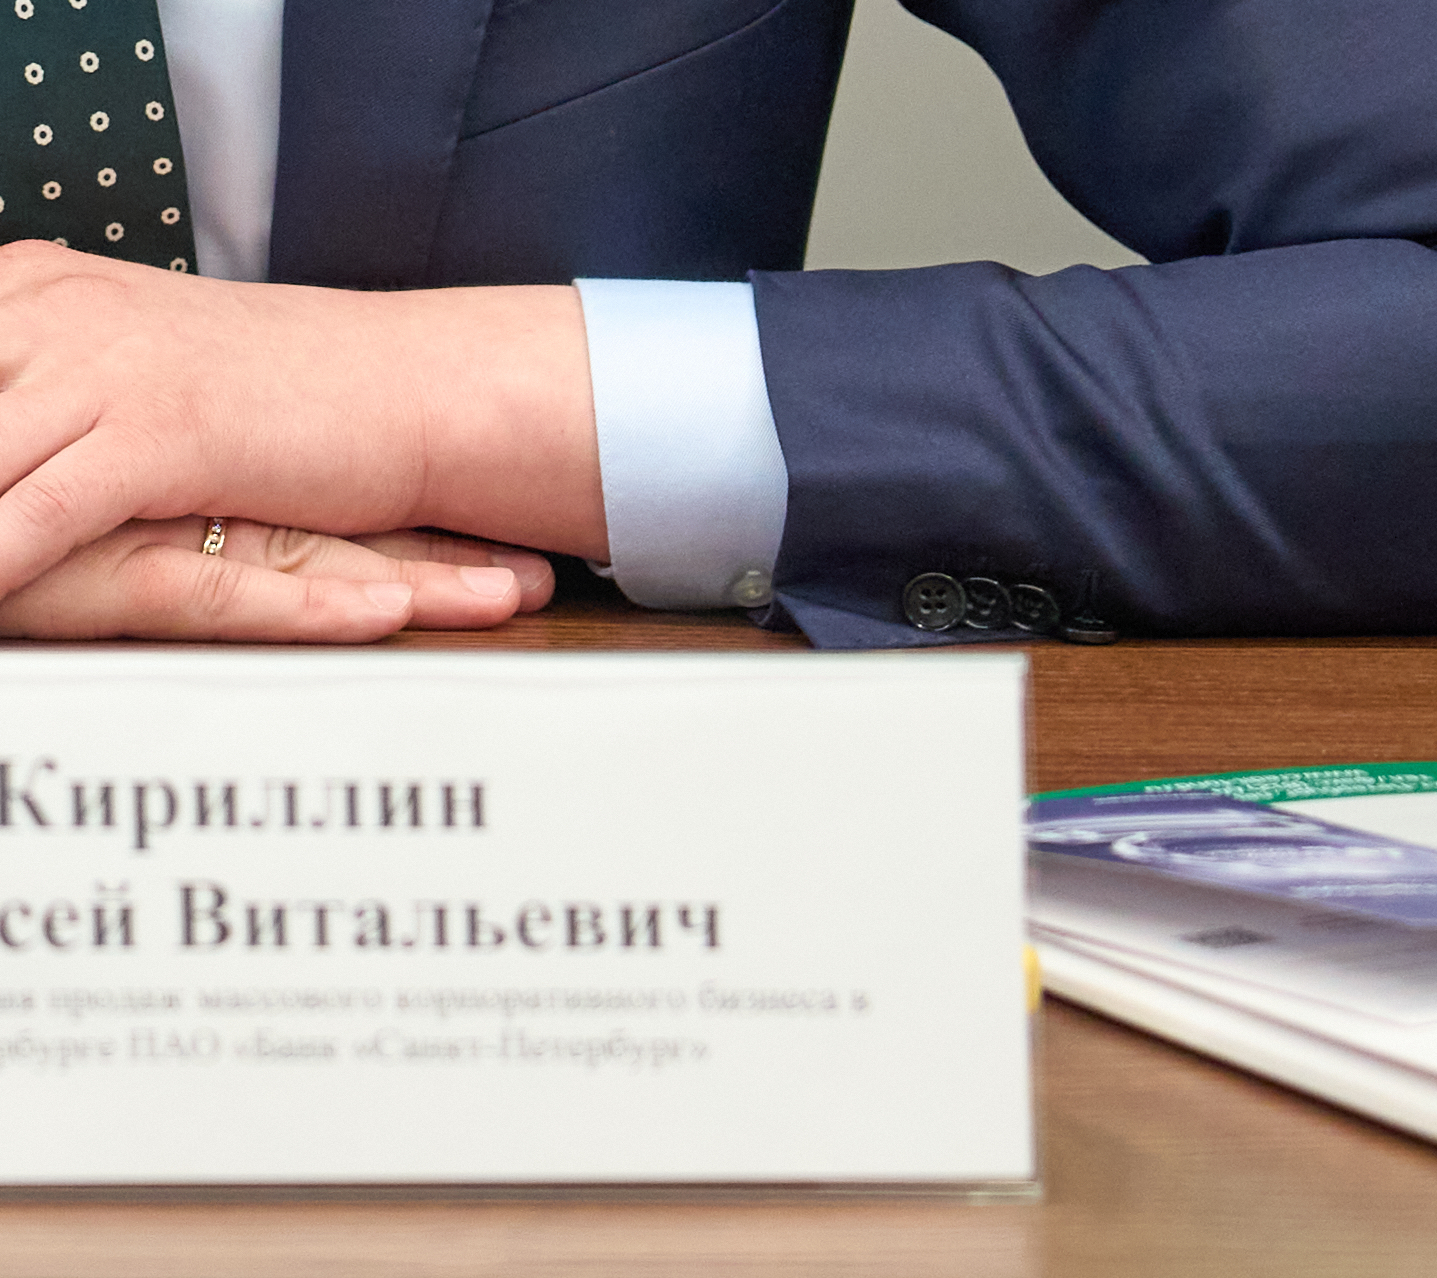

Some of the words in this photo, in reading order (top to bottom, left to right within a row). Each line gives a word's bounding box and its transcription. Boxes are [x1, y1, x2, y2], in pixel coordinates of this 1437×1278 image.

[176, 882, 724, 952] Витальевич
[197, 991, 383, 1014] массового
[395, 991, 687, 1020] корпоративного
[697, 984, 841, 1014] бизнеса
[127, 1031, 220, 1060] ПАО
